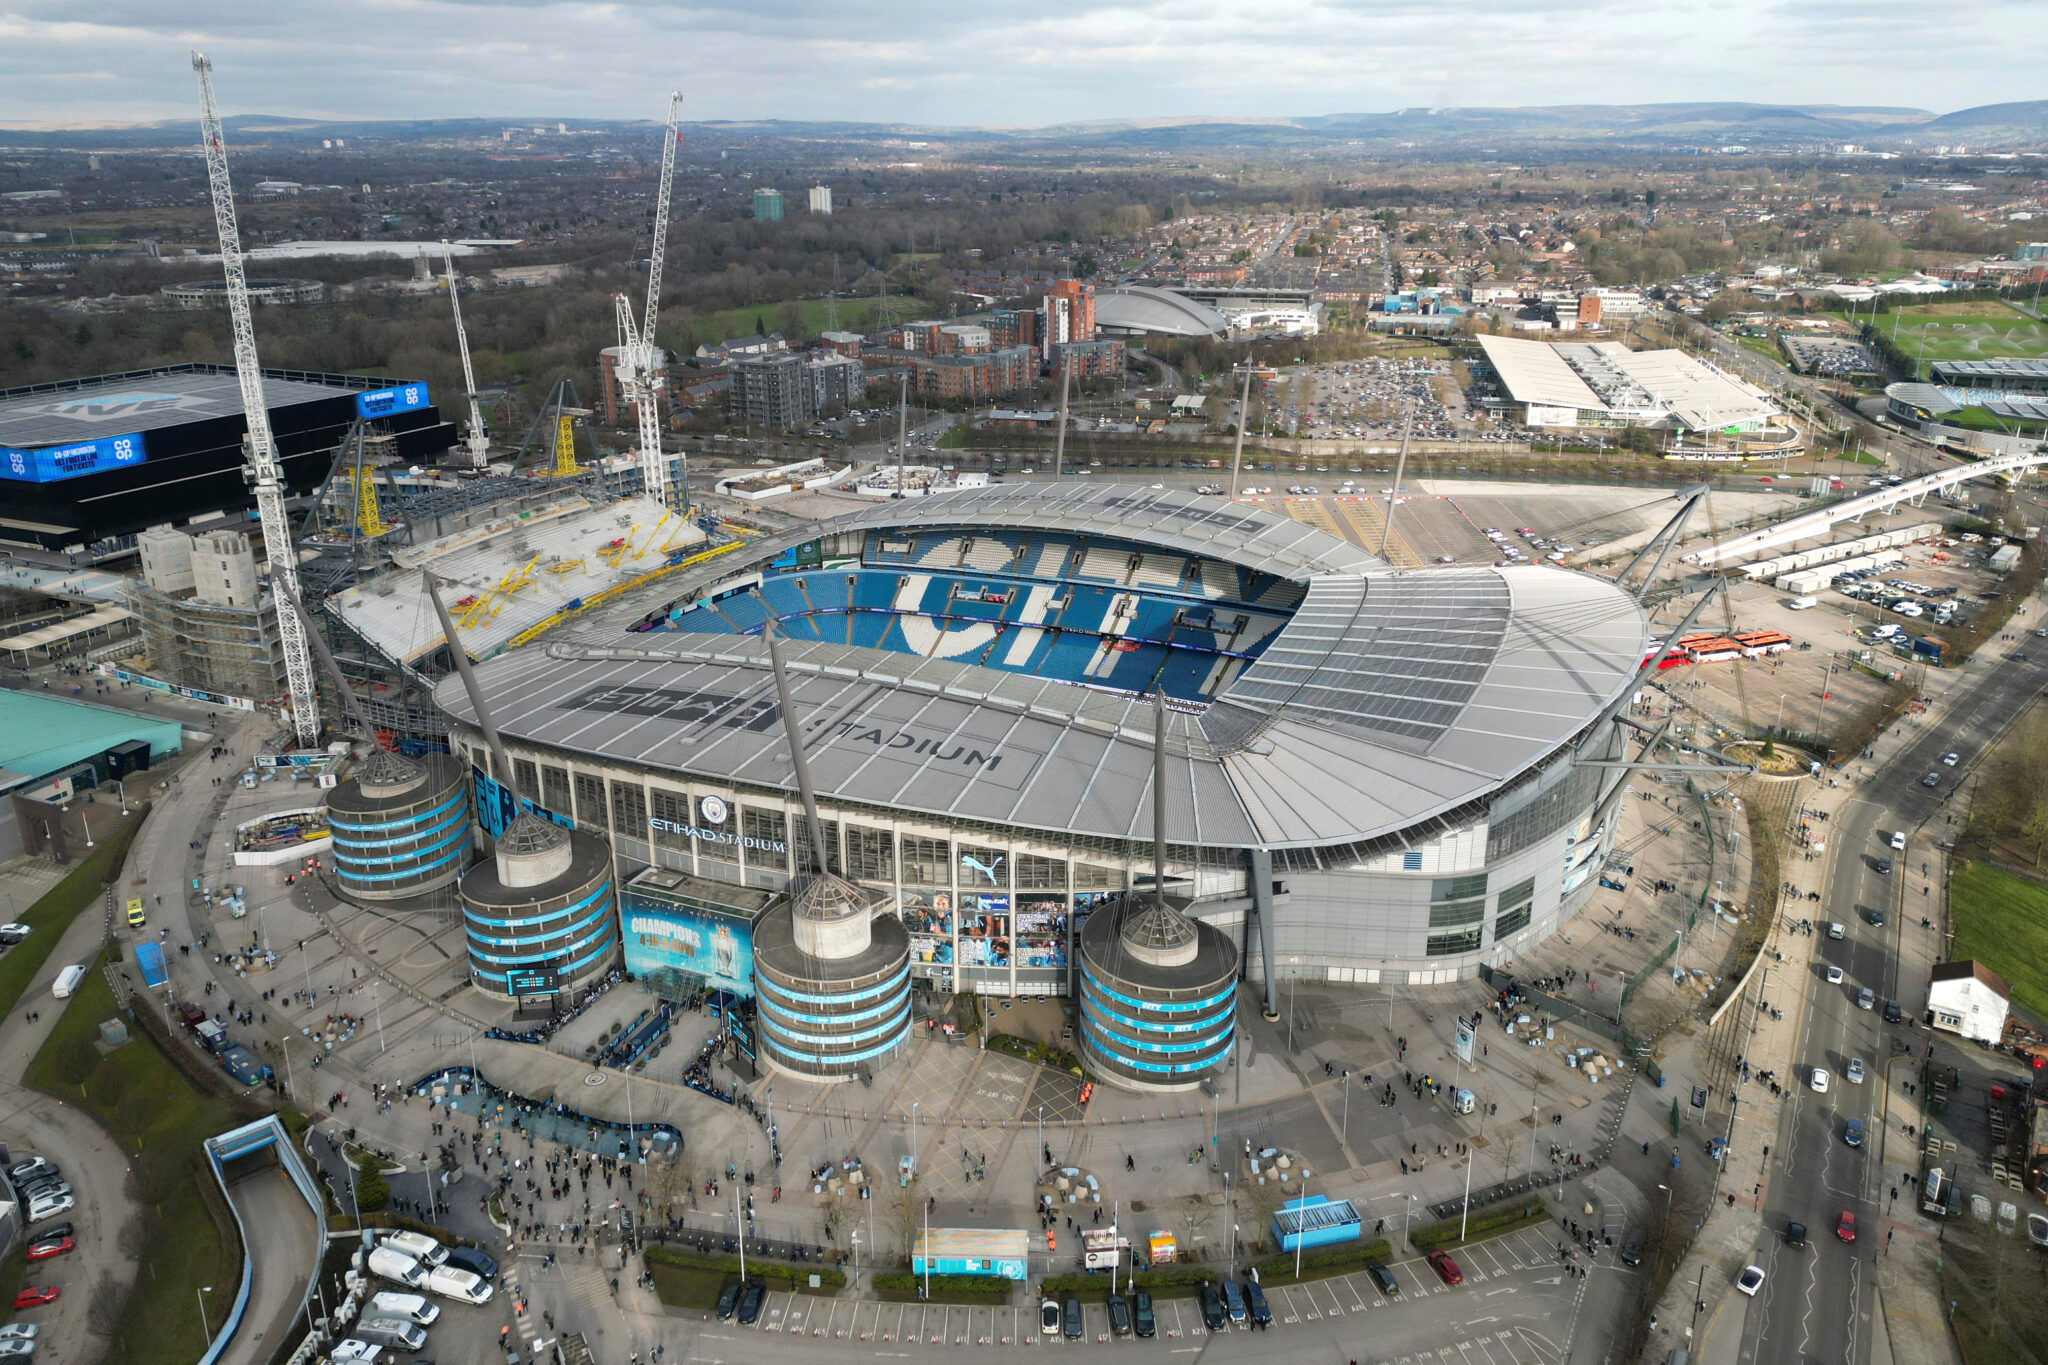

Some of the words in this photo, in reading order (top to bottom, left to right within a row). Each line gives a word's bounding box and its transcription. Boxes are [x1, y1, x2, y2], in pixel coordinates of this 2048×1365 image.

[649, 817, 716, 841] ETIHAD
[719, 831, 785, 853] STADIUM
[631, 917, 702, 948] CHAMPIONS
[1142, 1003, 1162, 1011] CITY
[1095, 1022, 1110, 1035] CITY
[1174, 1024, 1194, 1032] CITY
[1205, 1036, 1220, 1047] CITY
[1117, 1056, 1136, 1067] CITY
